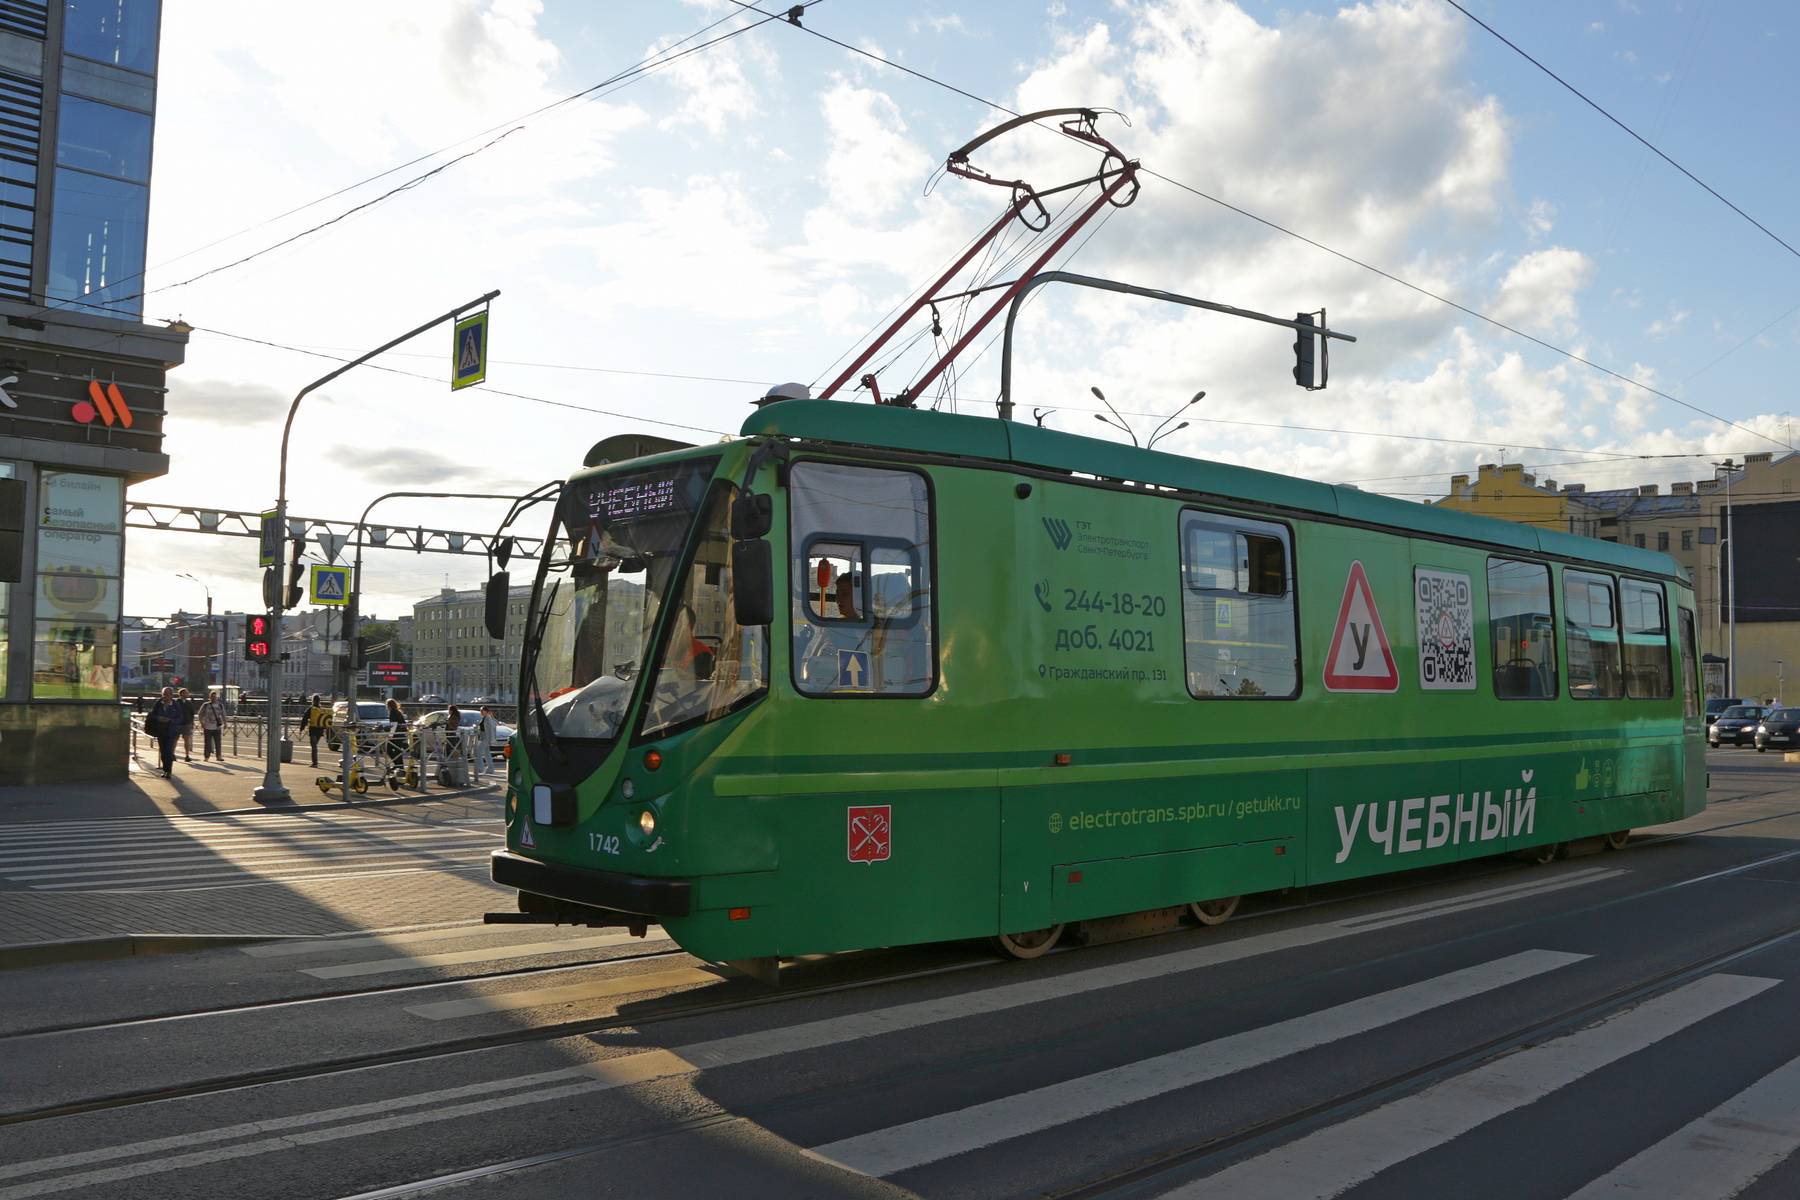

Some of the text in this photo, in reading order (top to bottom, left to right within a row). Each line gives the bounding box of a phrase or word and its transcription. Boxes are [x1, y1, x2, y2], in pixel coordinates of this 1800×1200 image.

[59, 479, 101, 490] билайн
[44, 507, 84, 518] самый
[44, 516, 117, 531] безопасный
[1076, 521, 1092, 530] ГЭТ
[44, 530, 102, 543] оператор
[1078, 532, 1149, 549] Электротранспорт
[1078, 544, 1148, 560] Санкт-Петербурга
[1064, 588, 1166, 617] 244-18-20
[1055, 624, 1154, 652] доб. 4021
[250, 642, 269, 656] 47
[1049, 666, 1129, 681] Гражданский
[1152, 669, 1167, 681] 131
[1069, 801, 1225, 830] electrotrans.spb.ru
[1236, 796, 1300, 819] getukk.ru
[1334, 769, 1536, 864] УЧЕБНЫЙ
[589, 833, 620, 855] 1742
